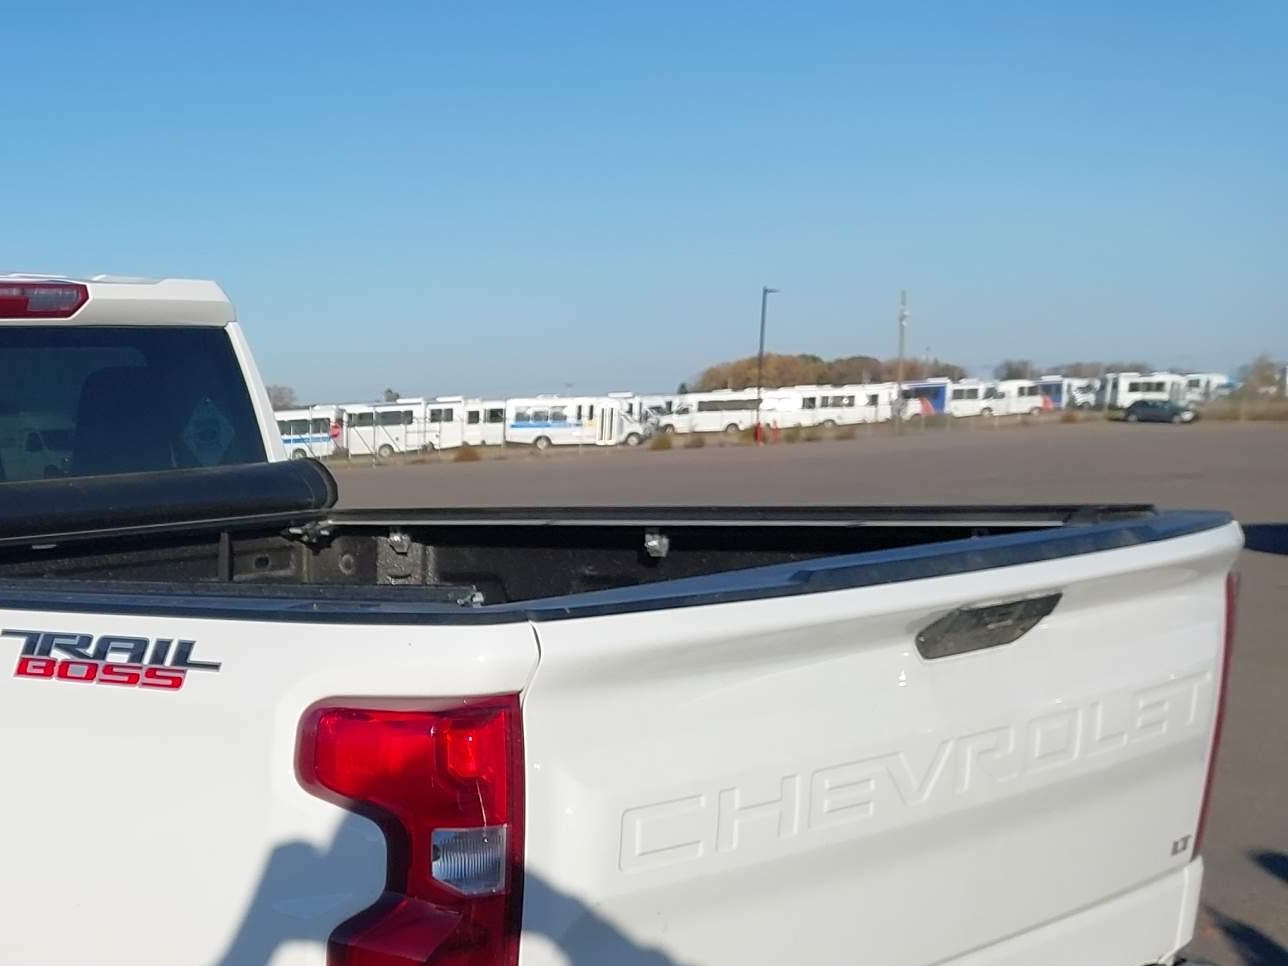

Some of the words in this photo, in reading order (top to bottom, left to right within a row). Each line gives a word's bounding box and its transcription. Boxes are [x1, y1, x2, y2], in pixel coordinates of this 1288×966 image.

[0, 629, 222, 672] TRAIL
[14, 657, 188, 692] BOSS
[618, 670, 1212, 873] CHEVROLET
